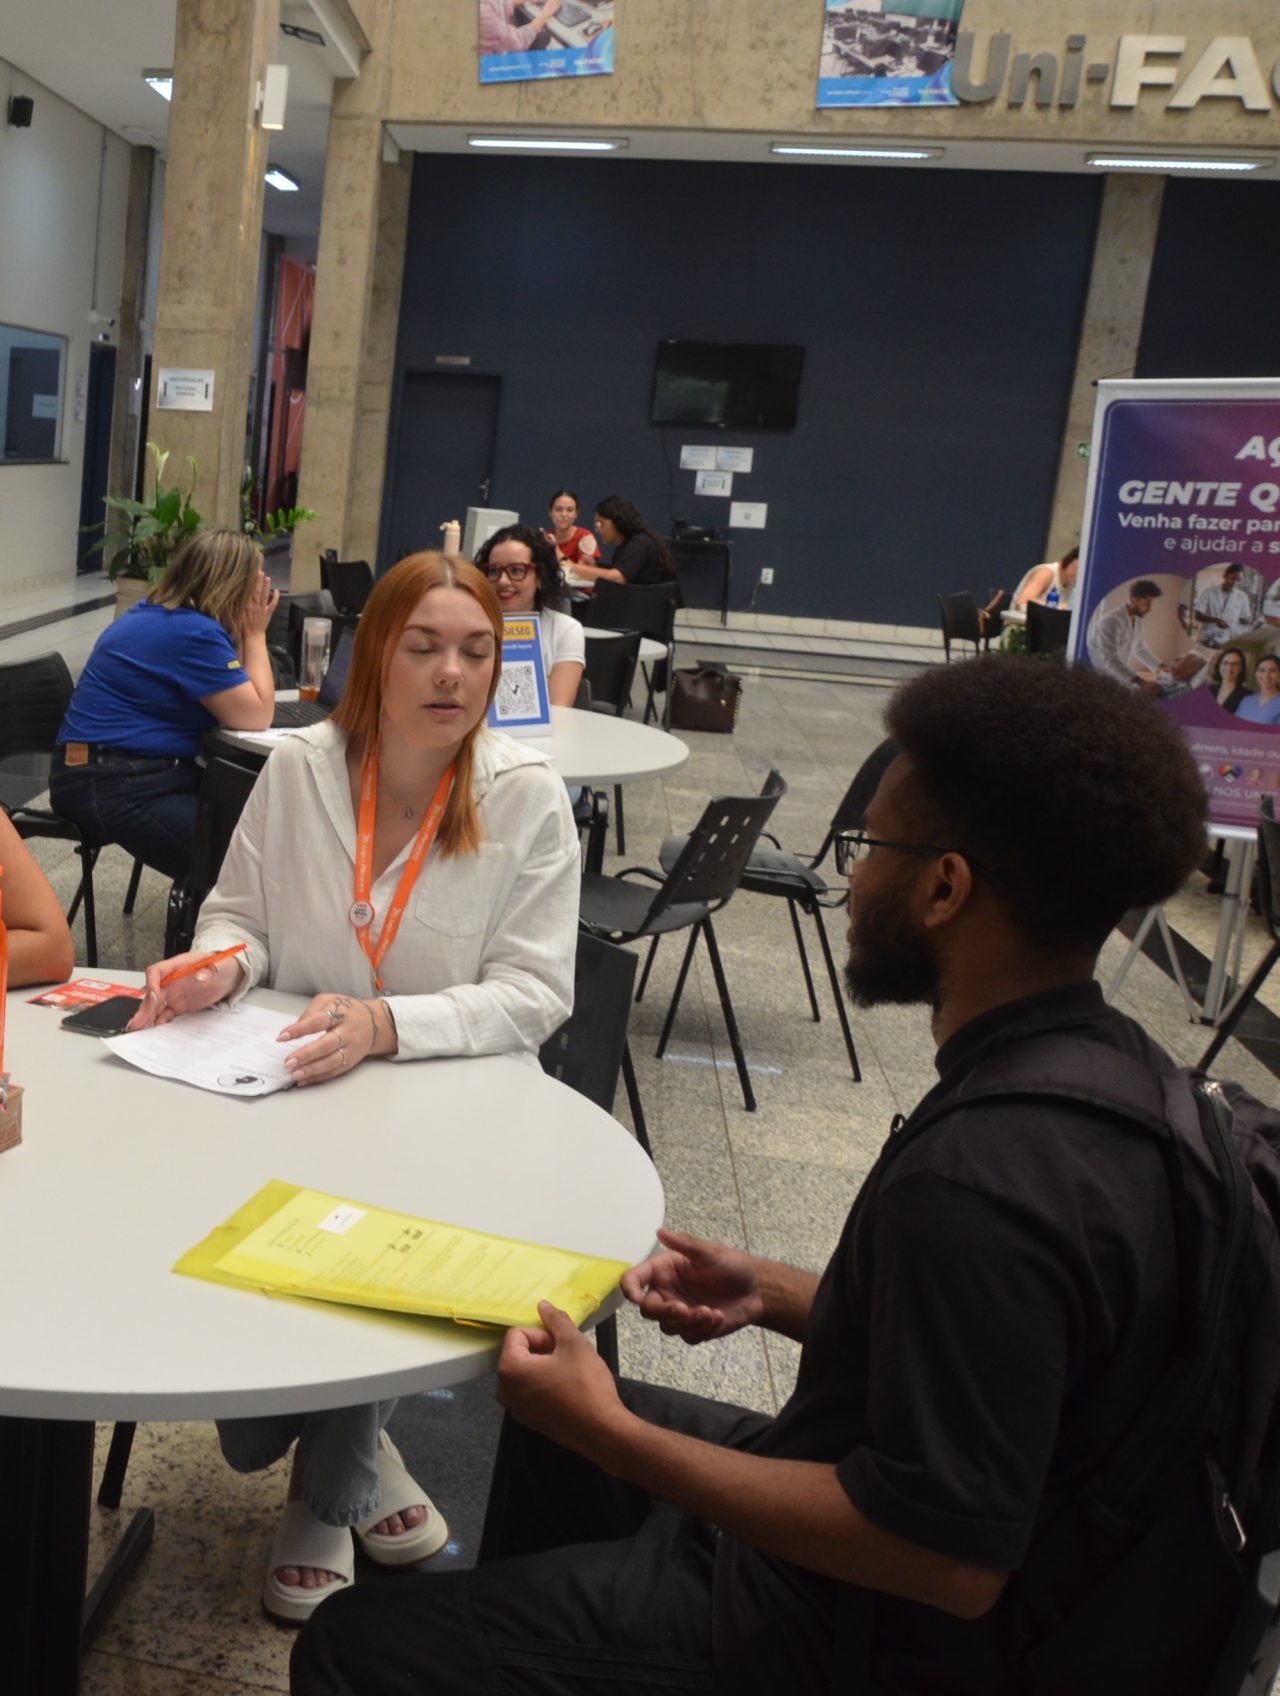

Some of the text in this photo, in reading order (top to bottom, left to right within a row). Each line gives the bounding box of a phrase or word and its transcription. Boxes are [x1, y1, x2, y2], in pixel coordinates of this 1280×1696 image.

[953, 32, 1280, 111] Uni-FA
[1118, 480, 1242, 506] GENTE
[1118, 512, 1182, 529] Venha
[1188, 514, 1241, 530] fazer
[1164, 537, 1176, 550] e
[1181, 535, 1246, 554] ajudar
[1251, 541, 1264, 553] a
